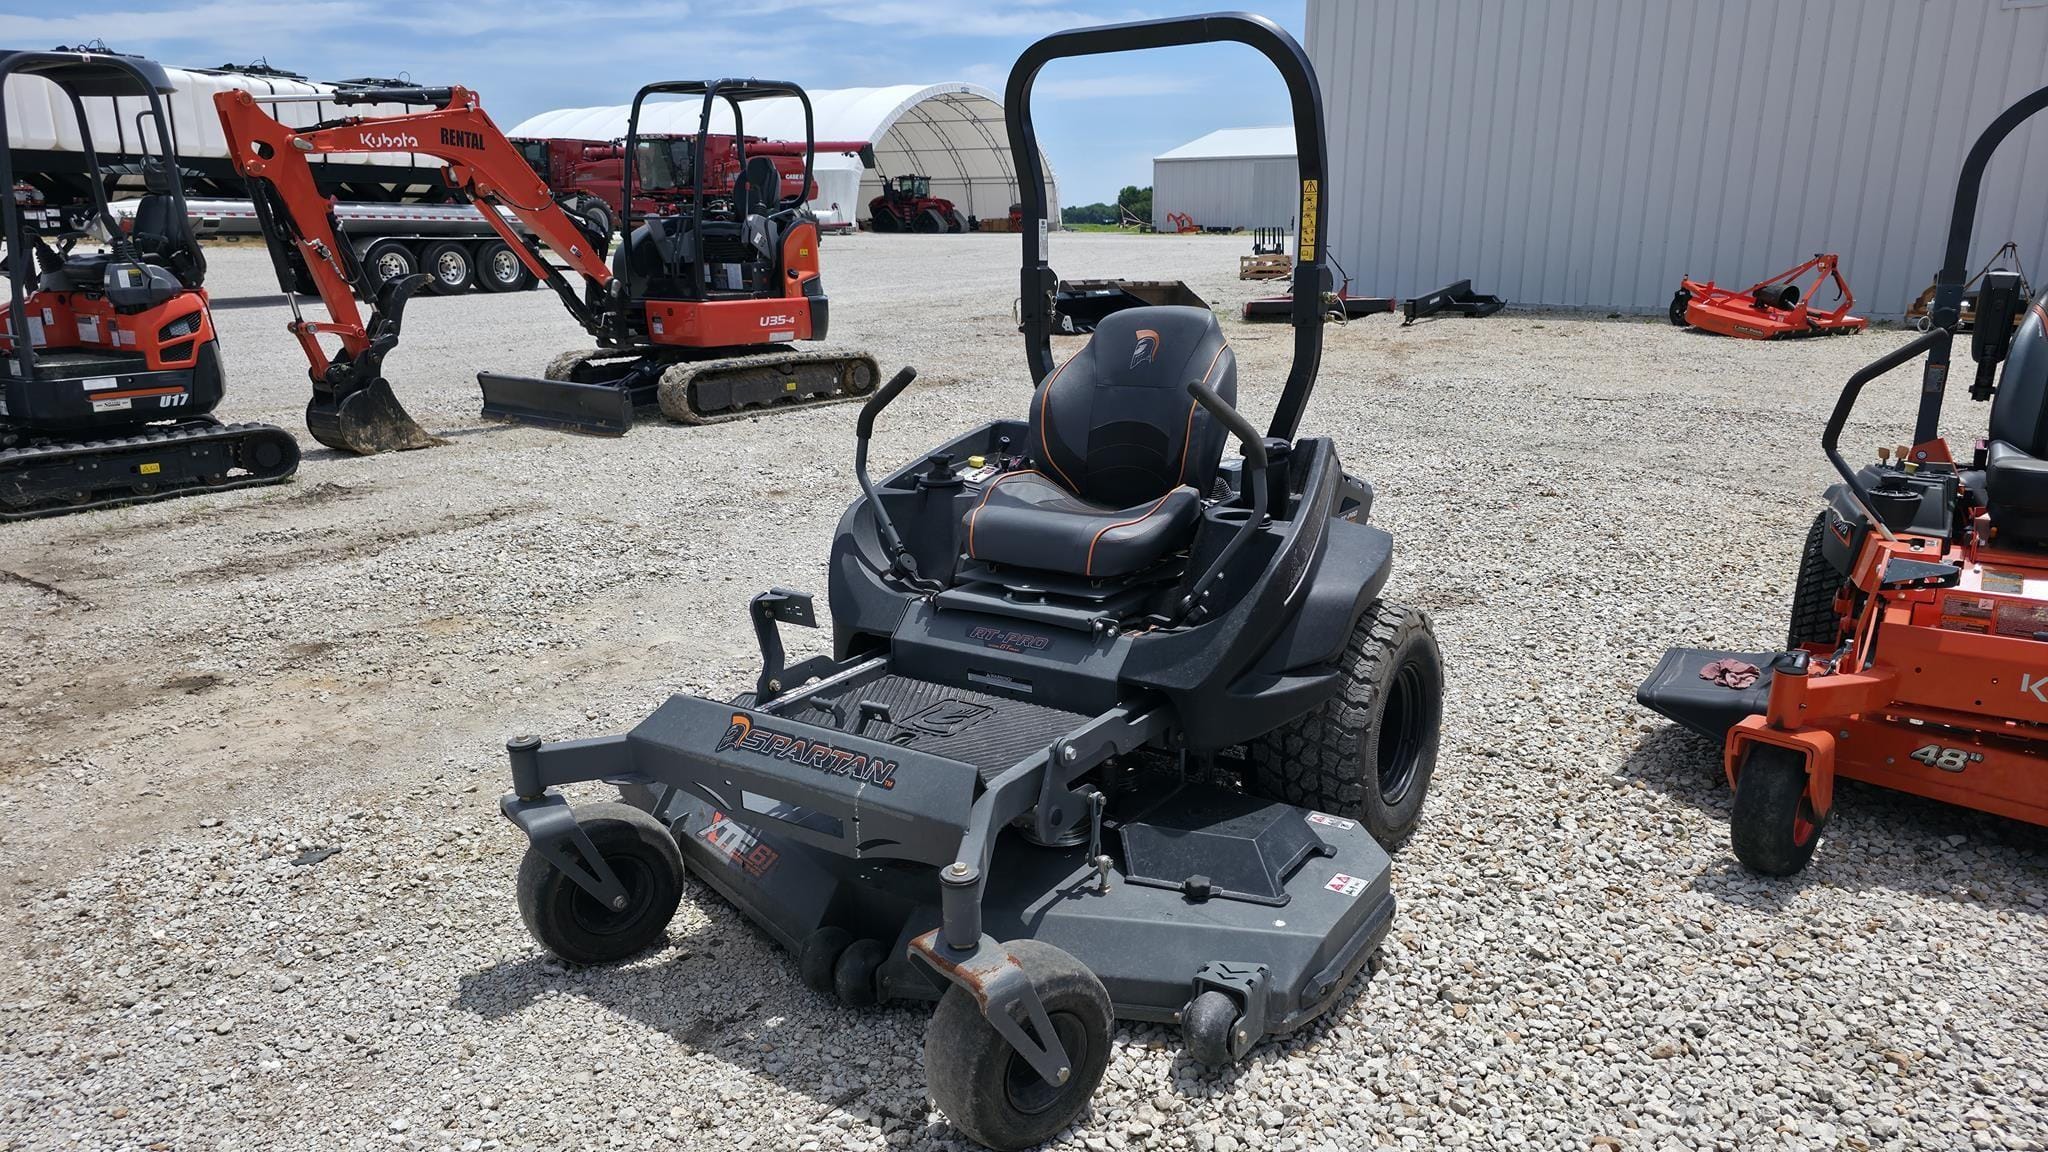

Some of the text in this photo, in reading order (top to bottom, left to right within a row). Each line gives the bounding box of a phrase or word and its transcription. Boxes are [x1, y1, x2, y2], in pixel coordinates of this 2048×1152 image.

[360, 133, 418, 148] Kubota
[440, 128, 485, 150] RENTAL
[760, 315, 795, 327] U35-4
[160, 393, 189, 408] U17
[969, 626, 1049, 650] RT-PRO
[740, 728, 896, 785] SPARTAN
[1909, 744, 1984, 773] 48"
